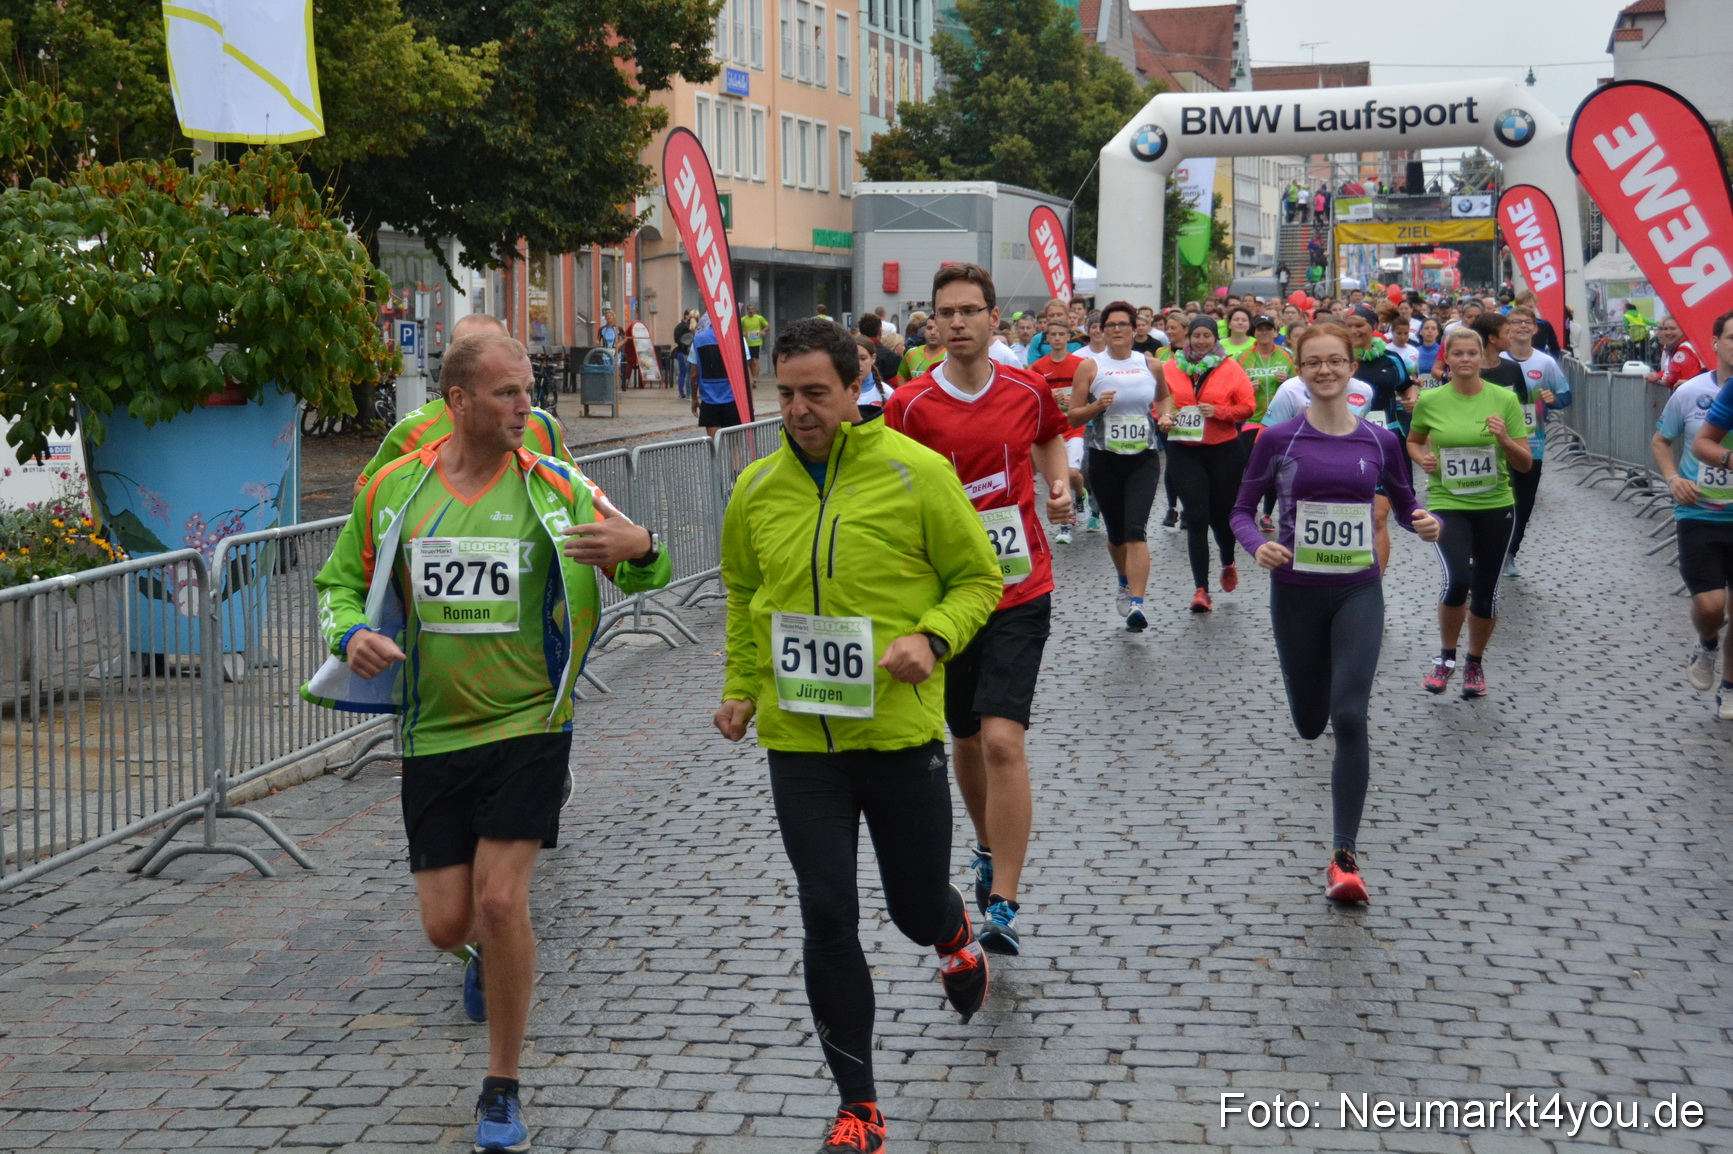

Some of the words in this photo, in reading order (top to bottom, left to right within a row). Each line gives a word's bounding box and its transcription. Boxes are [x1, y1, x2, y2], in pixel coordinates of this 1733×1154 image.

[1181, 104, 1283, 135] BMW
[1293, 97, 1479, 135] Laufsport
[1397, 226, 1433, 239] ZIEL
[403, 327, 413, 342] P
[1423, 379, 1440, 388] 183
[1111, 424, 1146, 439] 5104
[1446, 457, 1492, 477] 5144
[972, 480, 993, 494] DEHN
[1456, 479, 1483, 488] Yvonne
[1304, 519, 1364, 547] 5091
[459, 540, 510, 553] BOCK
[1316, 552, 1352, 564] Natalie
[424, 561, 510, 597] 5276
[443, 606, 491, 620] Roman
[781, 623, 809, 631] NeuerMarkt
[813, 619, 864, 633] BOCK
[781, 637, 863, 679] 5196
[796, 684, 843, 703] Jürgen
